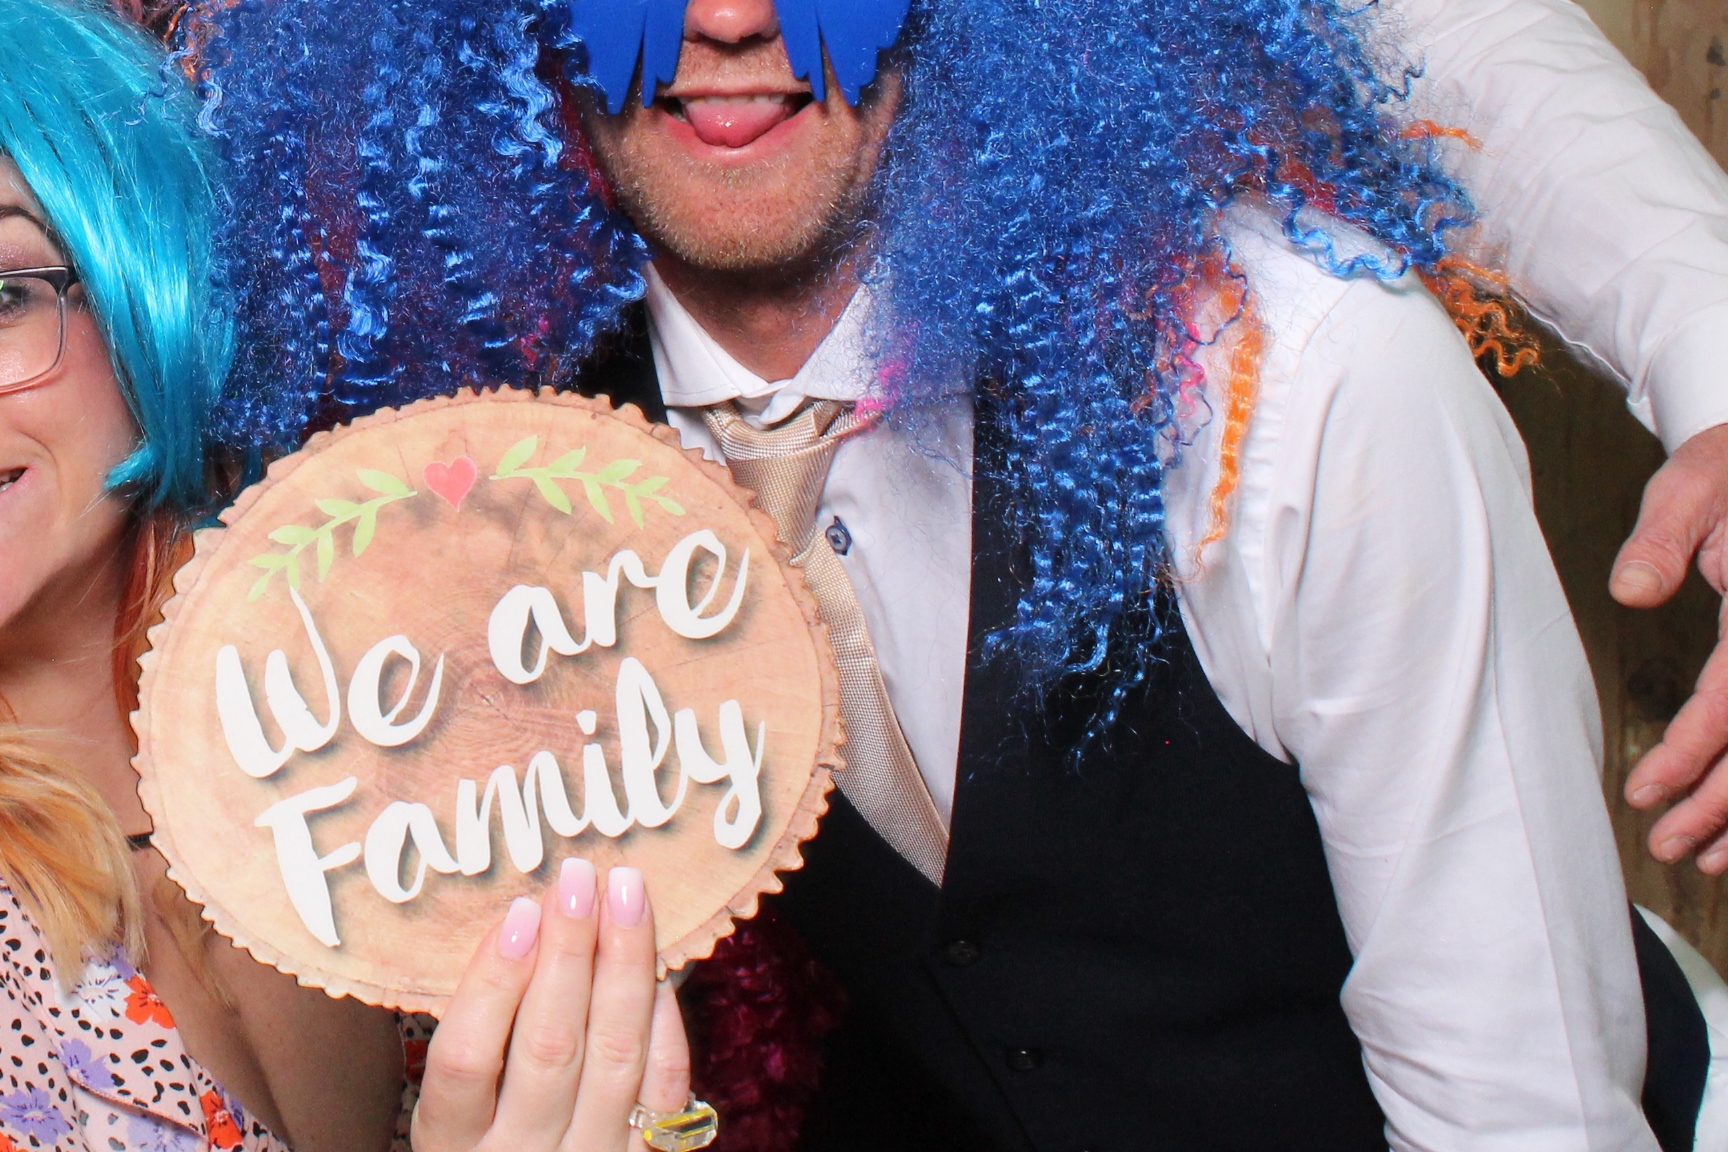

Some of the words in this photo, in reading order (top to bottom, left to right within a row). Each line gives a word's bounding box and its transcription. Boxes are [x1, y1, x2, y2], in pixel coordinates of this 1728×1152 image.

[216, 585, 444, 779] We
[487, 528, 750, 685] are
[254, 656, 766, 947] Family
